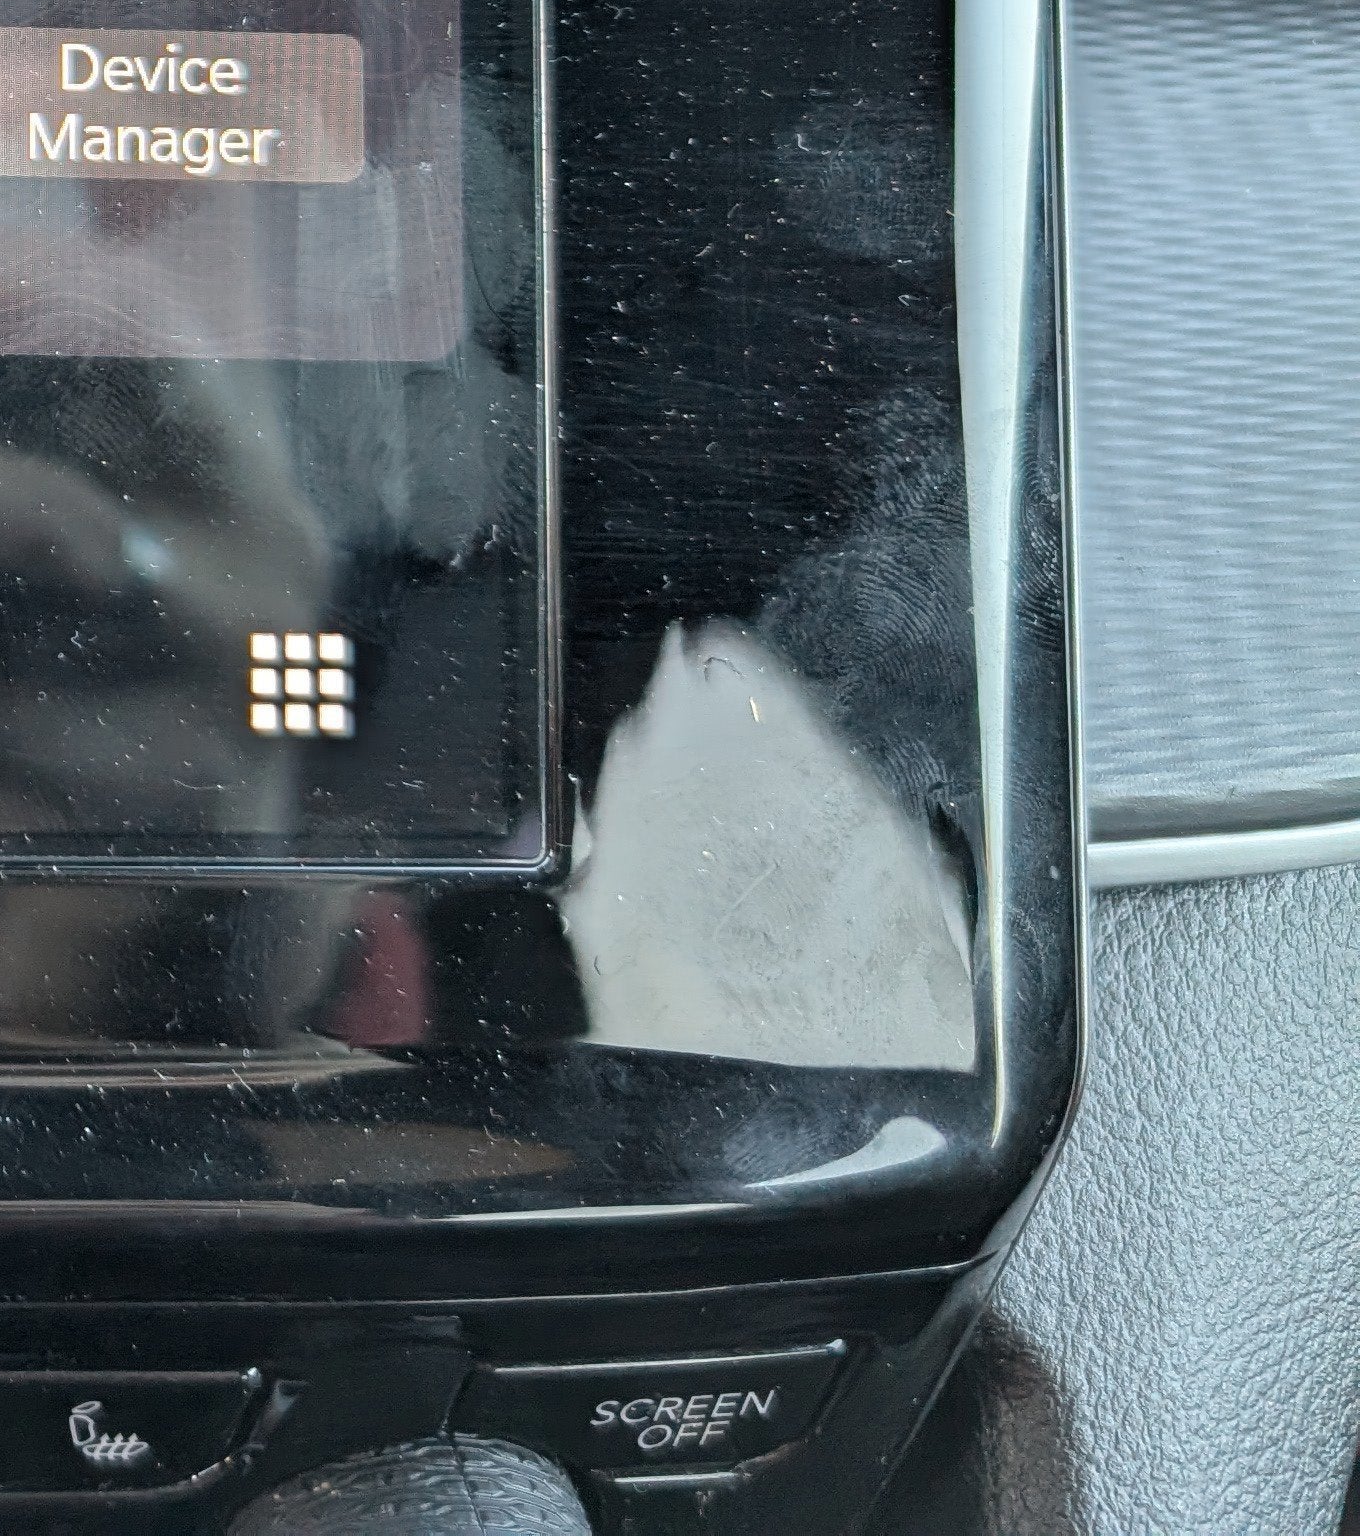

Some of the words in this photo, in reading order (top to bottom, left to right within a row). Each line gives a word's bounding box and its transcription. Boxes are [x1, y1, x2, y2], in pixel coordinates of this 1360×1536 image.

[59, 43, 247, 96] Device
[26, 114, 275, 174] Manager
[590, 1389, 772, 1426] SCREEN
[637, 1421, 730, 1449] OFF
